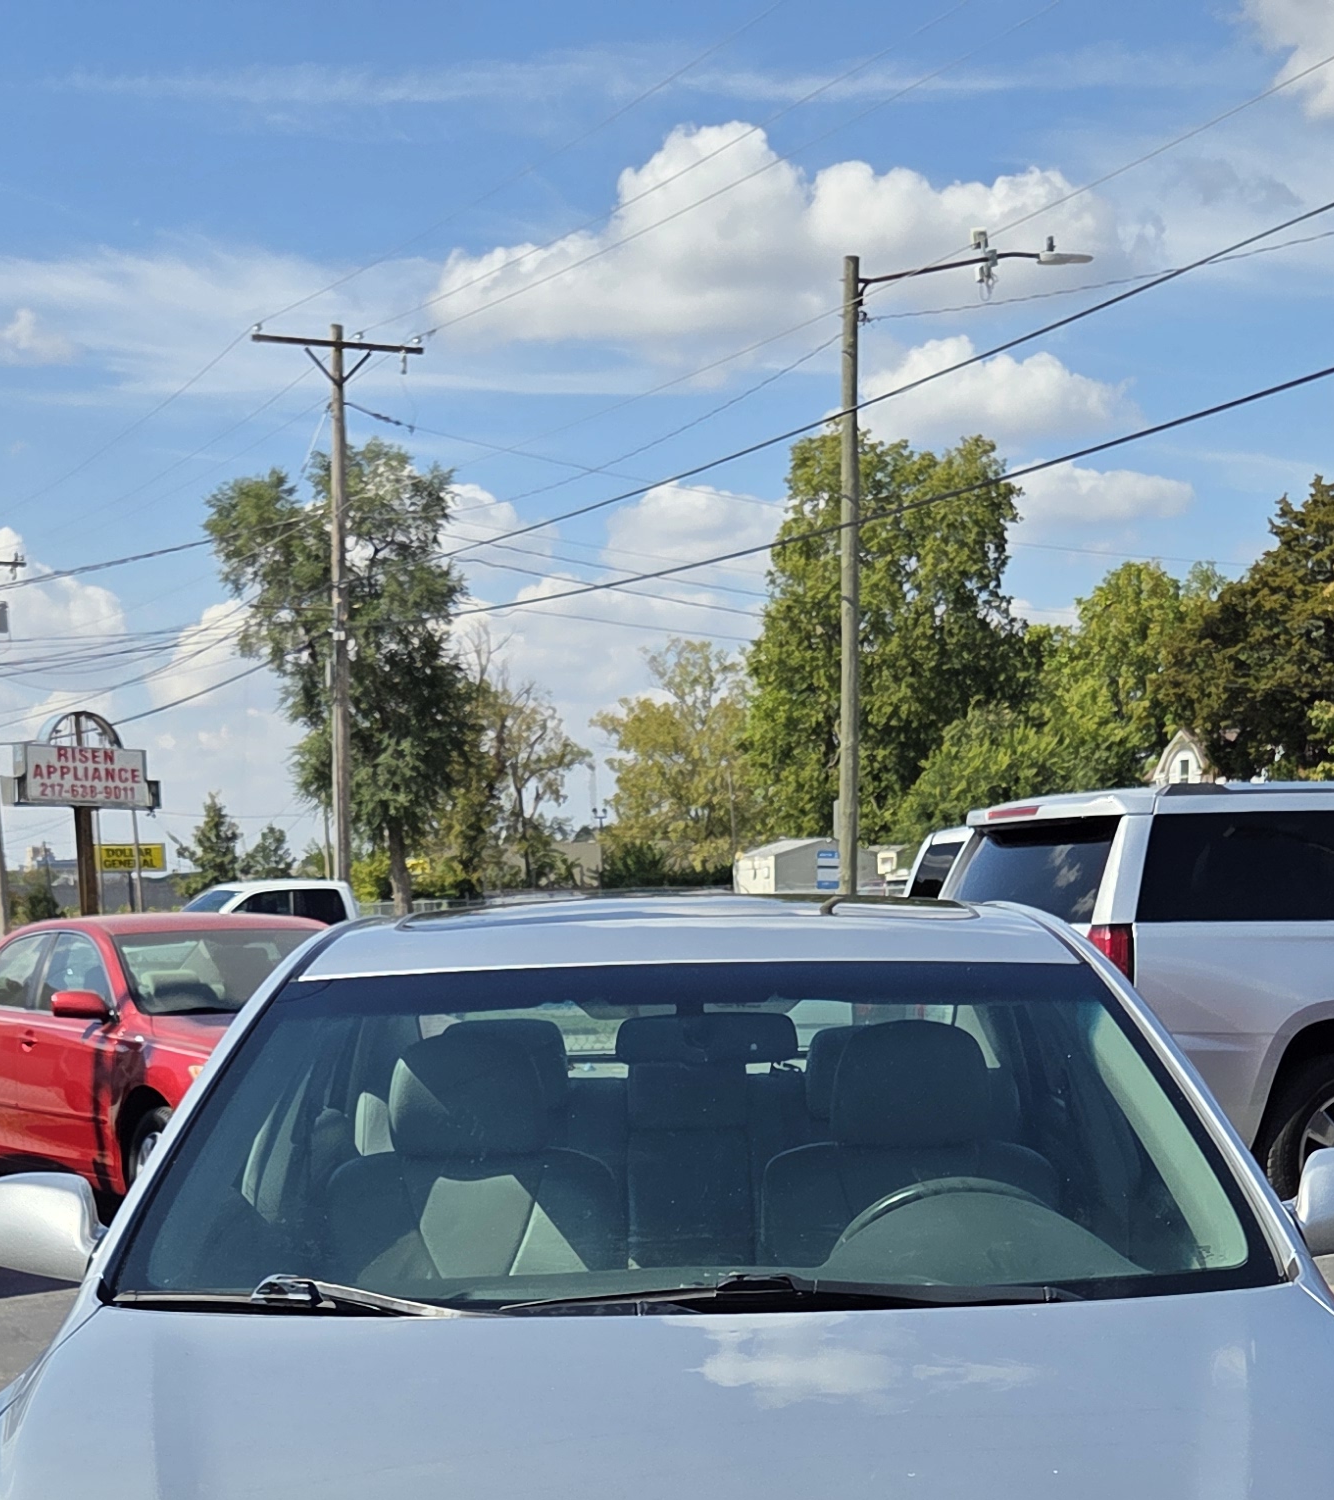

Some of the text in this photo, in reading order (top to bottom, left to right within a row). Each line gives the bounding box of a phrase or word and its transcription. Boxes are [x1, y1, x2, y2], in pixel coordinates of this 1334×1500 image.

[57, 748, 115, 765] RISEN
[33, 764, 142, 784] APPLIANCE
[103, 859, 157, 869] GENEAL
